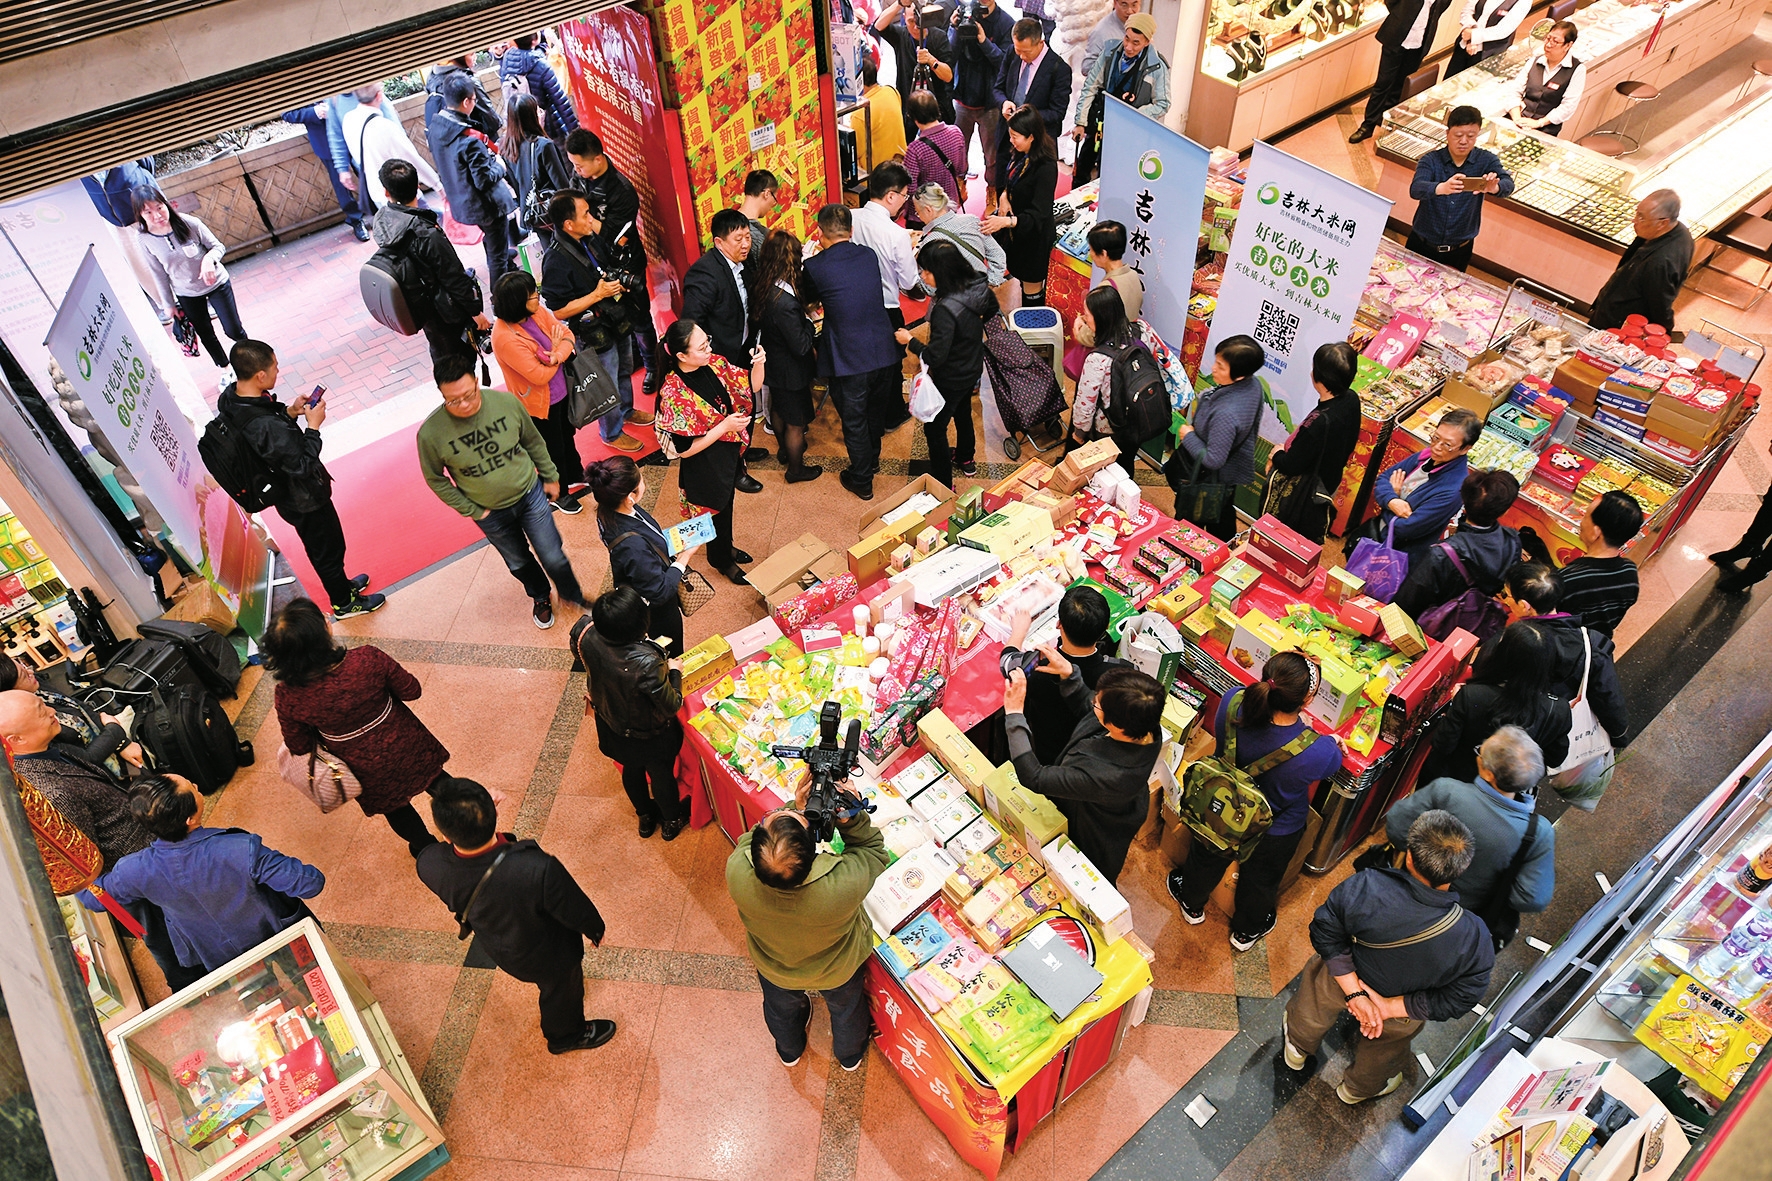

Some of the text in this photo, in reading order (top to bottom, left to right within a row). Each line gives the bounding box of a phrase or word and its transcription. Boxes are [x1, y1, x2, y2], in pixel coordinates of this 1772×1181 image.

[705, 19, 734, 50] 新貨
[709, 40, 737, 71] 登場
[751, 36, 778, 66] 新貨
[582, 67, 643, 126] 香港展示會
[720, 117, 746, 146] 新貨
[723, 135, 749, 165] 登場
[1282, 190, 1357, 239] 吉林大米网
[1254, 221, 1340, 277] 好吃的大米
[1252, 247, 1328, 297] 吉林大米
[82, 292, 112, 356] 吉林大米网
[102, 335, 134, 408] 好吃的大米
[448, 416, 510, 455] I WANT
[1490, 423, 1505, 432] CREAM
[458, 441, 523, 479] BELIEVE
[472, 440, 500, 461] TO
[900, 924, 930, 946] 火山岩
[939, 944, 967, 970] 火山岩
[986, 993, 1016, 1018] 火山岩
